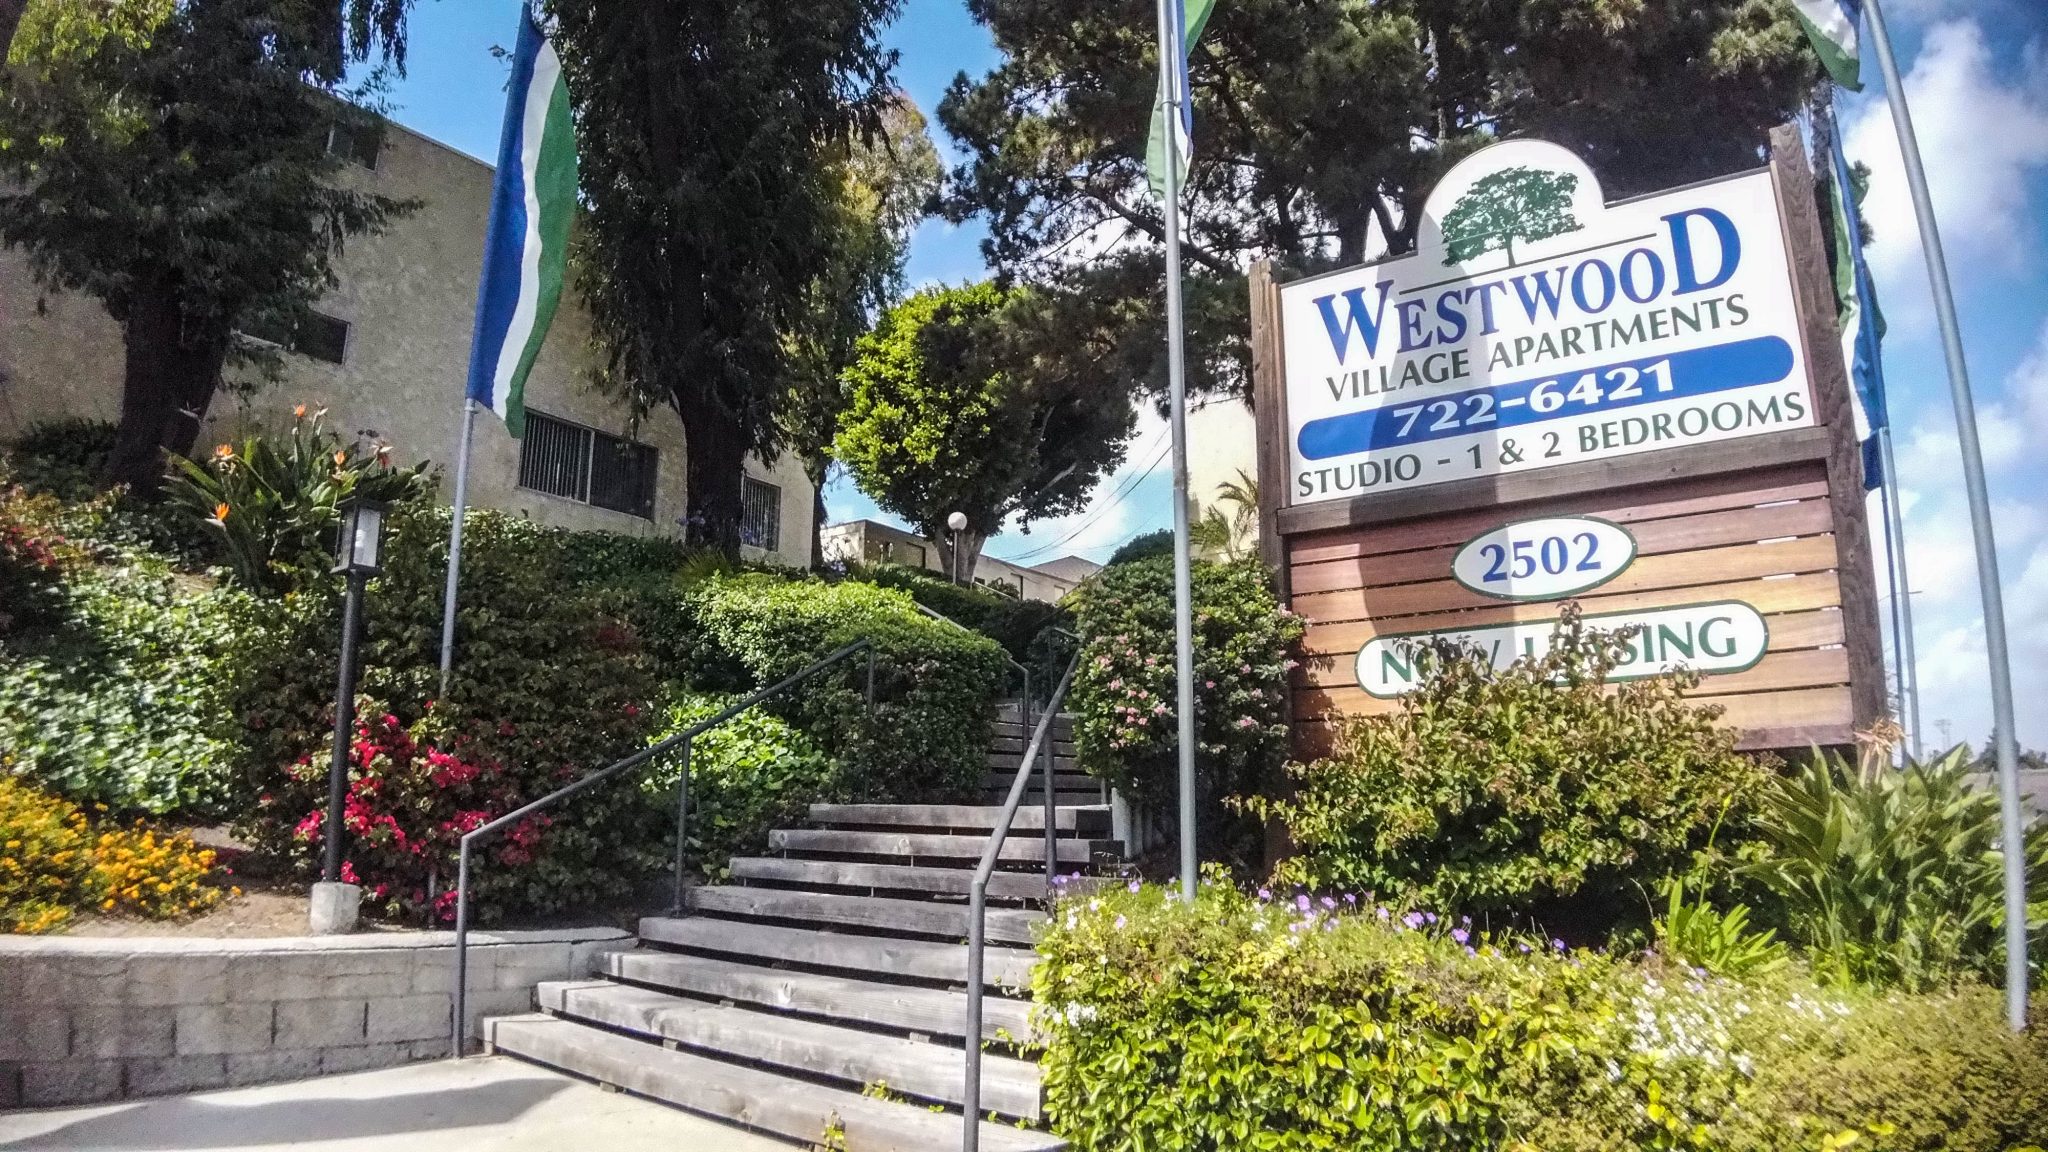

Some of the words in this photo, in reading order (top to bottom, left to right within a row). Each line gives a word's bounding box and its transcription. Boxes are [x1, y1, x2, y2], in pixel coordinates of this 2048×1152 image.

[1313, 207, 1742, 366] WESTWOOD
[1326, 348, 1470, 402] VILLAGE
[1488, 293, 1750, 373] APARTMENTS
[1393, 359, 1675, 439] 722-6421
[1298, 453, 1421, 498] STUDIO
[1467, 446, 1482, 469] 1
[1499, 439, 1525, 465] &
[1542, 432, 1562, 458] 2
[1579, 391, 1806, 453] BEDROOMS
[1480, 532, 1602, 583] 2502
